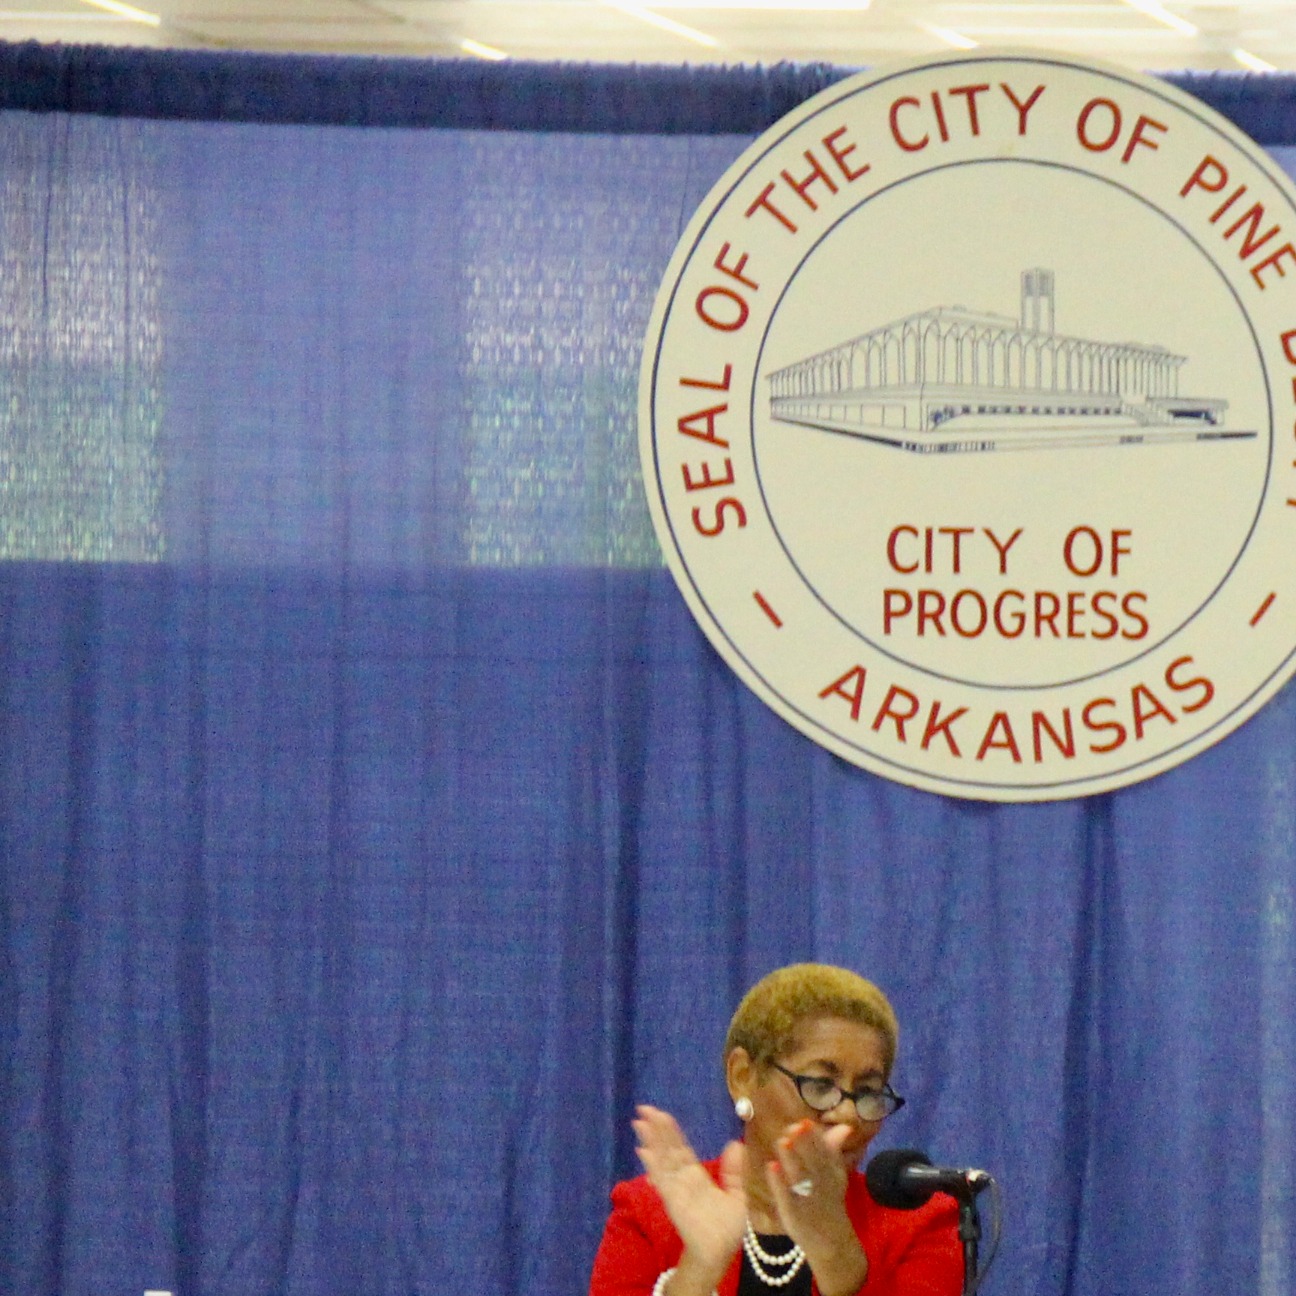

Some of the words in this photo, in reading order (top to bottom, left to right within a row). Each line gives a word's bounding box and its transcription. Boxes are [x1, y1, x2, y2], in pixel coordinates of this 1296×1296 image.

[889, 83, 1046, 153] CITY
[1077, 97, 1168, 164] OF
[745, 126, 871, 234] THE
[695, 242, 760, 333] OF
[678, 362, 747, 538] SEAL
[886, 524, 1024, 575] CITY
[1063, 525, 1132, 577] OF
[882, 589, 1150, 641] PROGRESS
[818, 655, 1216, 765] ARKANSAS
